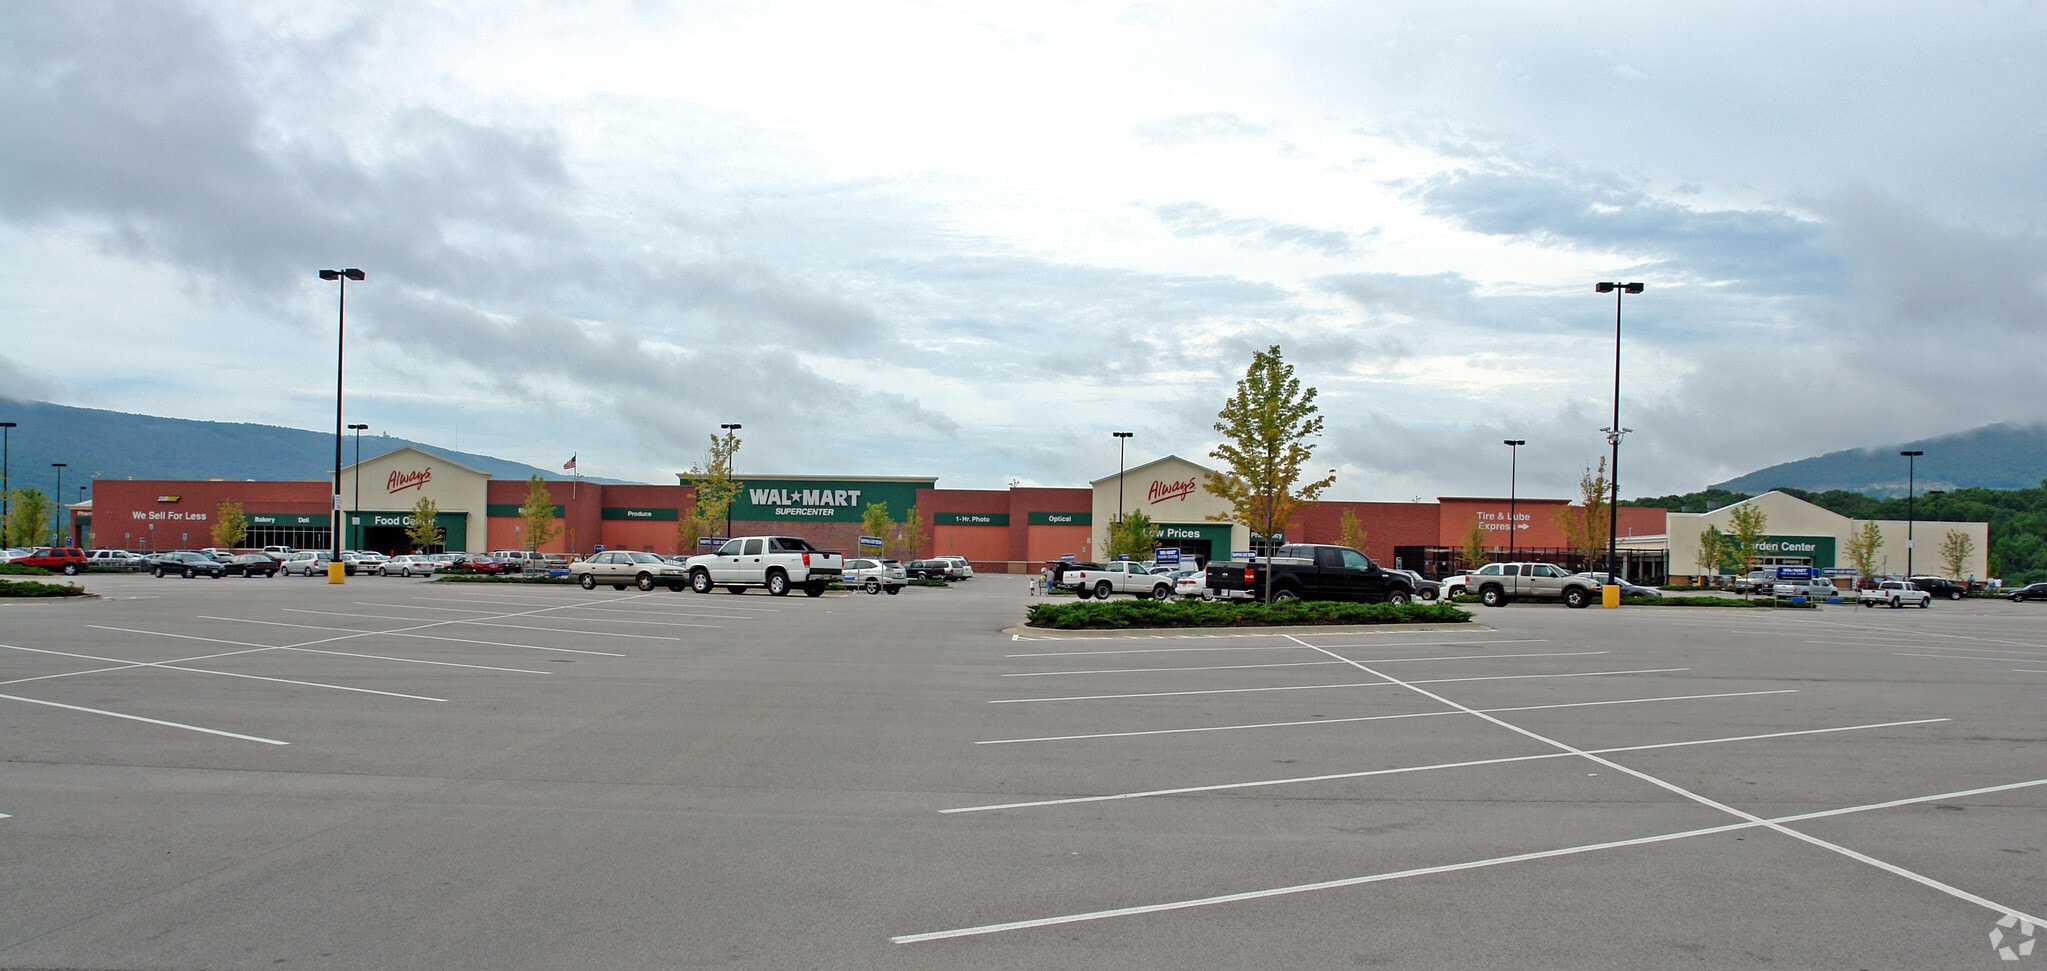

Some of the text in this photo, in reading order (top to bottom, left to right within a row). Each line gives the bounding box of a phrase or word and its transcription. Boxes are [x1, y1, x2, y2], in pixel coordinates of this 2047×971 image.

[387, 467, 432, 493] Always
[1148, 477, 1196, 504] Always
[132, 511, 207, 521] We Sell For Less
[775, 507, 835, 516] SUPERCENTER
[1476, 511, 1531, 521] Tire & Lube
[254, 516, 275, 524] Bakery
[374, 515, 435, 526] Food Ceer
[1048, 515, 1072, 523] Optical
[1167, 528, 1201, 538] Prices
[1781, 541, 1816, 552] Center
